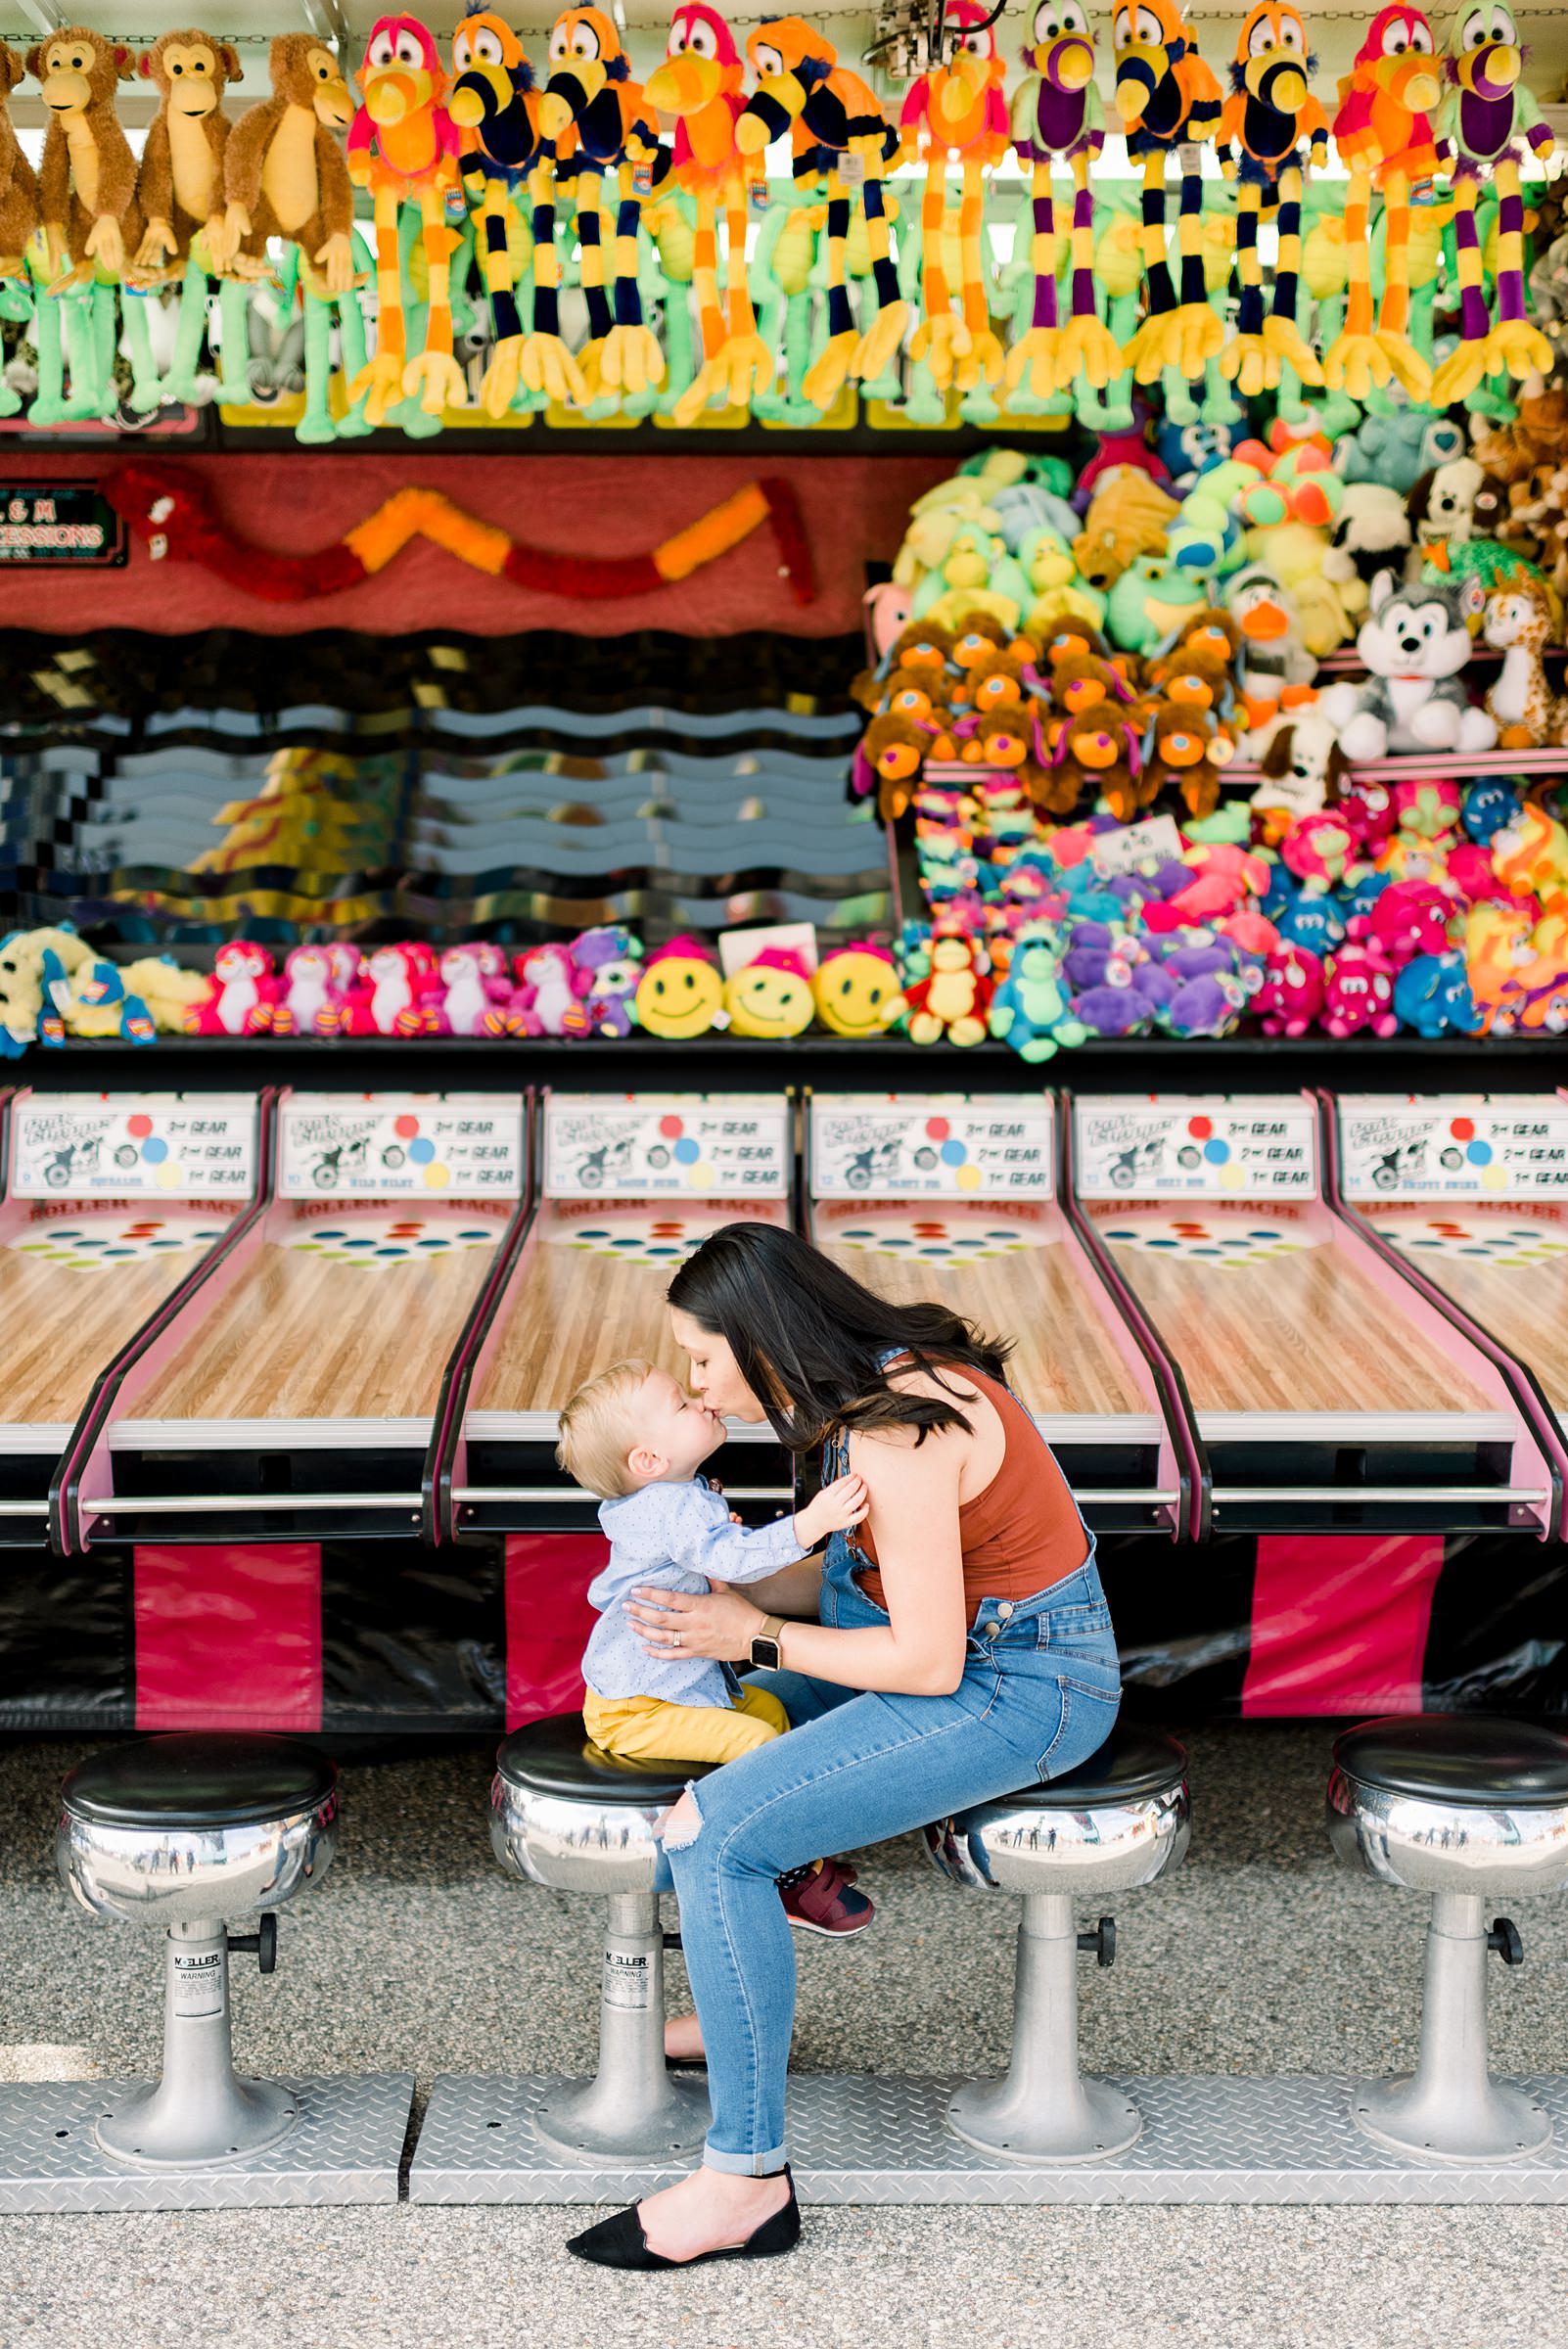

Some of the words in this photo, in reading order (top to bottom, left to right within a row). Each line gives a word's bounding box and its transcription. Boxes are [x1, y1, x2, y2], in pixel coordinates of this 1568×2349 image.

[32, 497, 58, 523] M
[190, 1122, 227, 1134] GEAR
[456, 1122, 493, 1134] GEAR
[722, 1122, 759, 1134] GEAR
[989, 1125, 1026, 1136] GEAR
[1251, 1123, 1287, 1135] GEAR
[1512, 1125, 1549, 1136] GEAR
[205, 1146, 242, 1160] GEAR
[472, 1146, 509, 1160] GEAR
[736, 1146, 773, 1160] GEAR
[1004, 1149, 1041, 1162] GEAR
[1267, 1148, 1304, 1160] GEAR
[1529, 1149, 1565, 1161] GEAR
[209, 1171, 247, 1183] GEAR
[476, 1171, 514, 1183] GEAR
[741, 1171, 779, 1184] GEAR
[1009, 1173, 1046, 1185] GEAR
[1272, 1172, 1309, 1183] GEAR
[180, 1969, 215, 1980] WARNING
